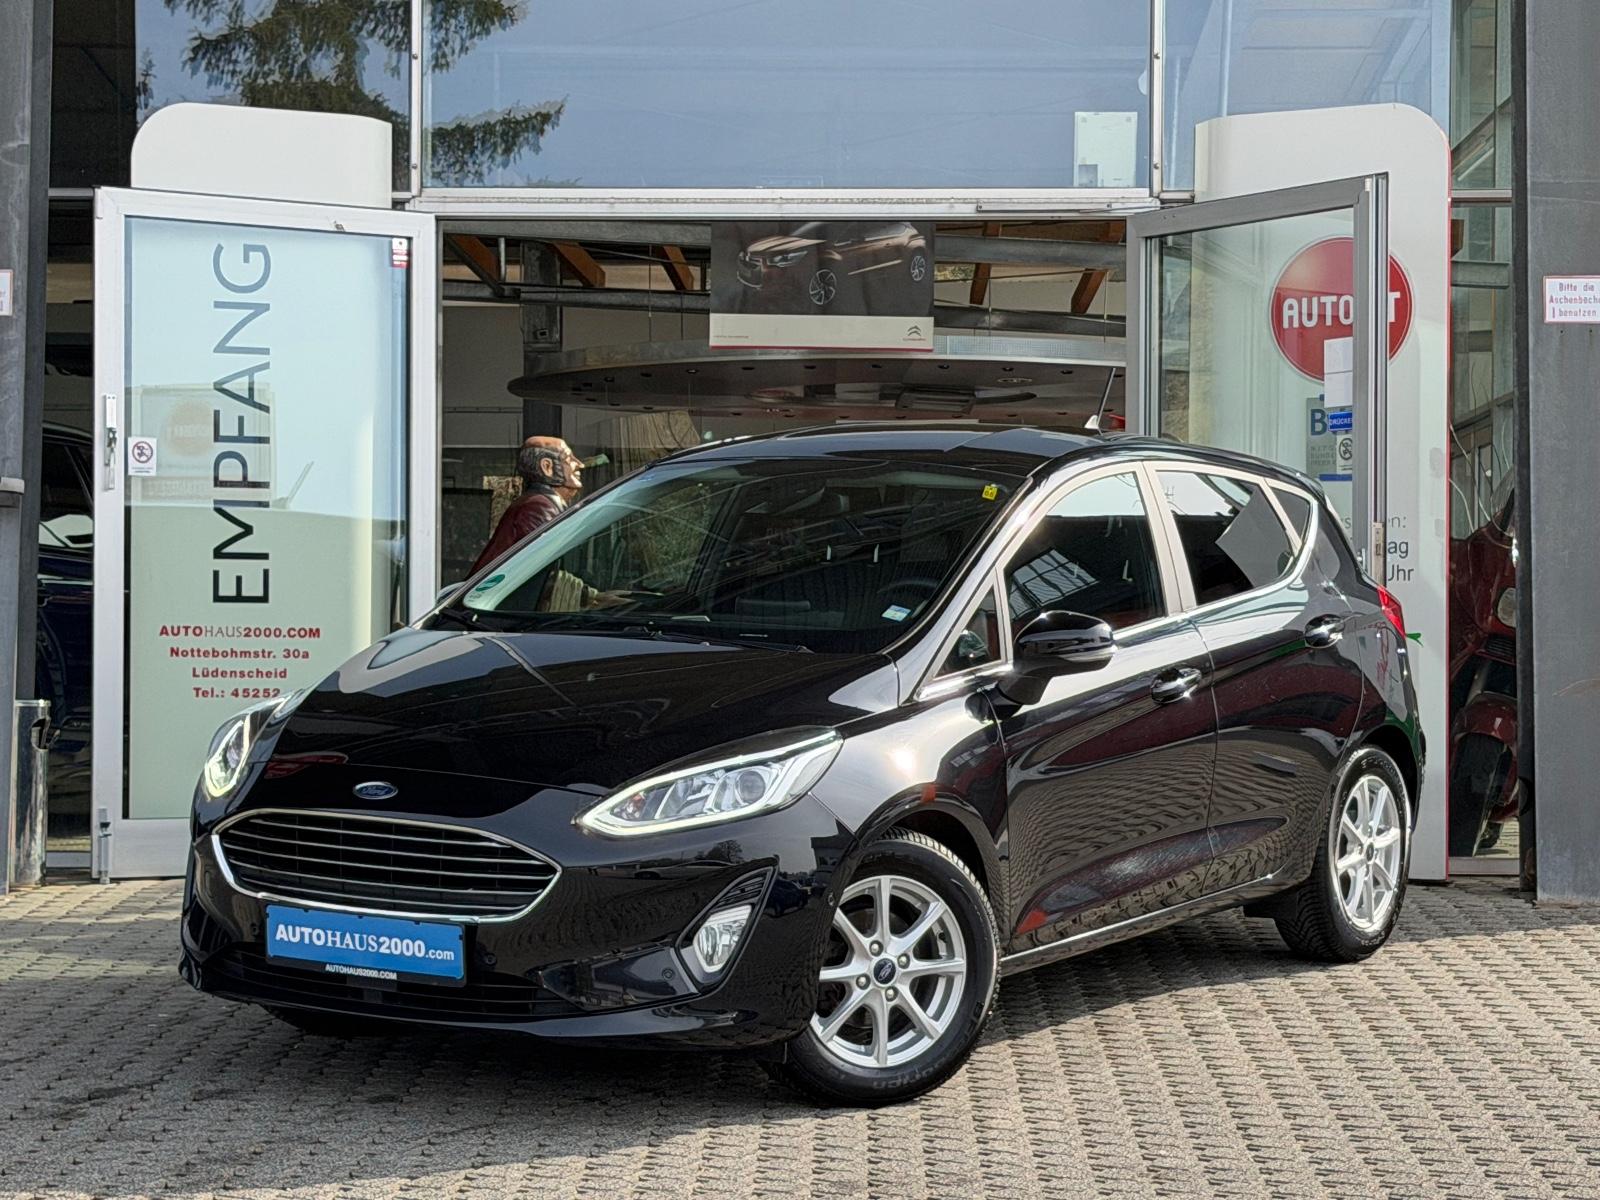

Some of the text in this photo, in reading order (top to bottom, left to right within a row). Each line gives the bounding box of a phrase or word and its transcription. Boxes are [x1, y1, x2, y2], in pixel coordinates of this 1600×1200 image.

[1559, 282, 1594, 292] Bitte die
[1559, 308, 1597, 317] benutzen
[213, 243, 271, 603] EMPFANG
[159, 625, 321, 639] AUTOHAUS2000.COM
[170, 647, 310, 659] Nottebohmstr. 30a
[192, 667, 288, 679] Lüdenscheid
[193, 687, 225, 698] Tel.:
[275, 924, 455, 960] AUTOHAUS2000.com
[325, 963, 398, 980] AUTOHAUS2000.COM
